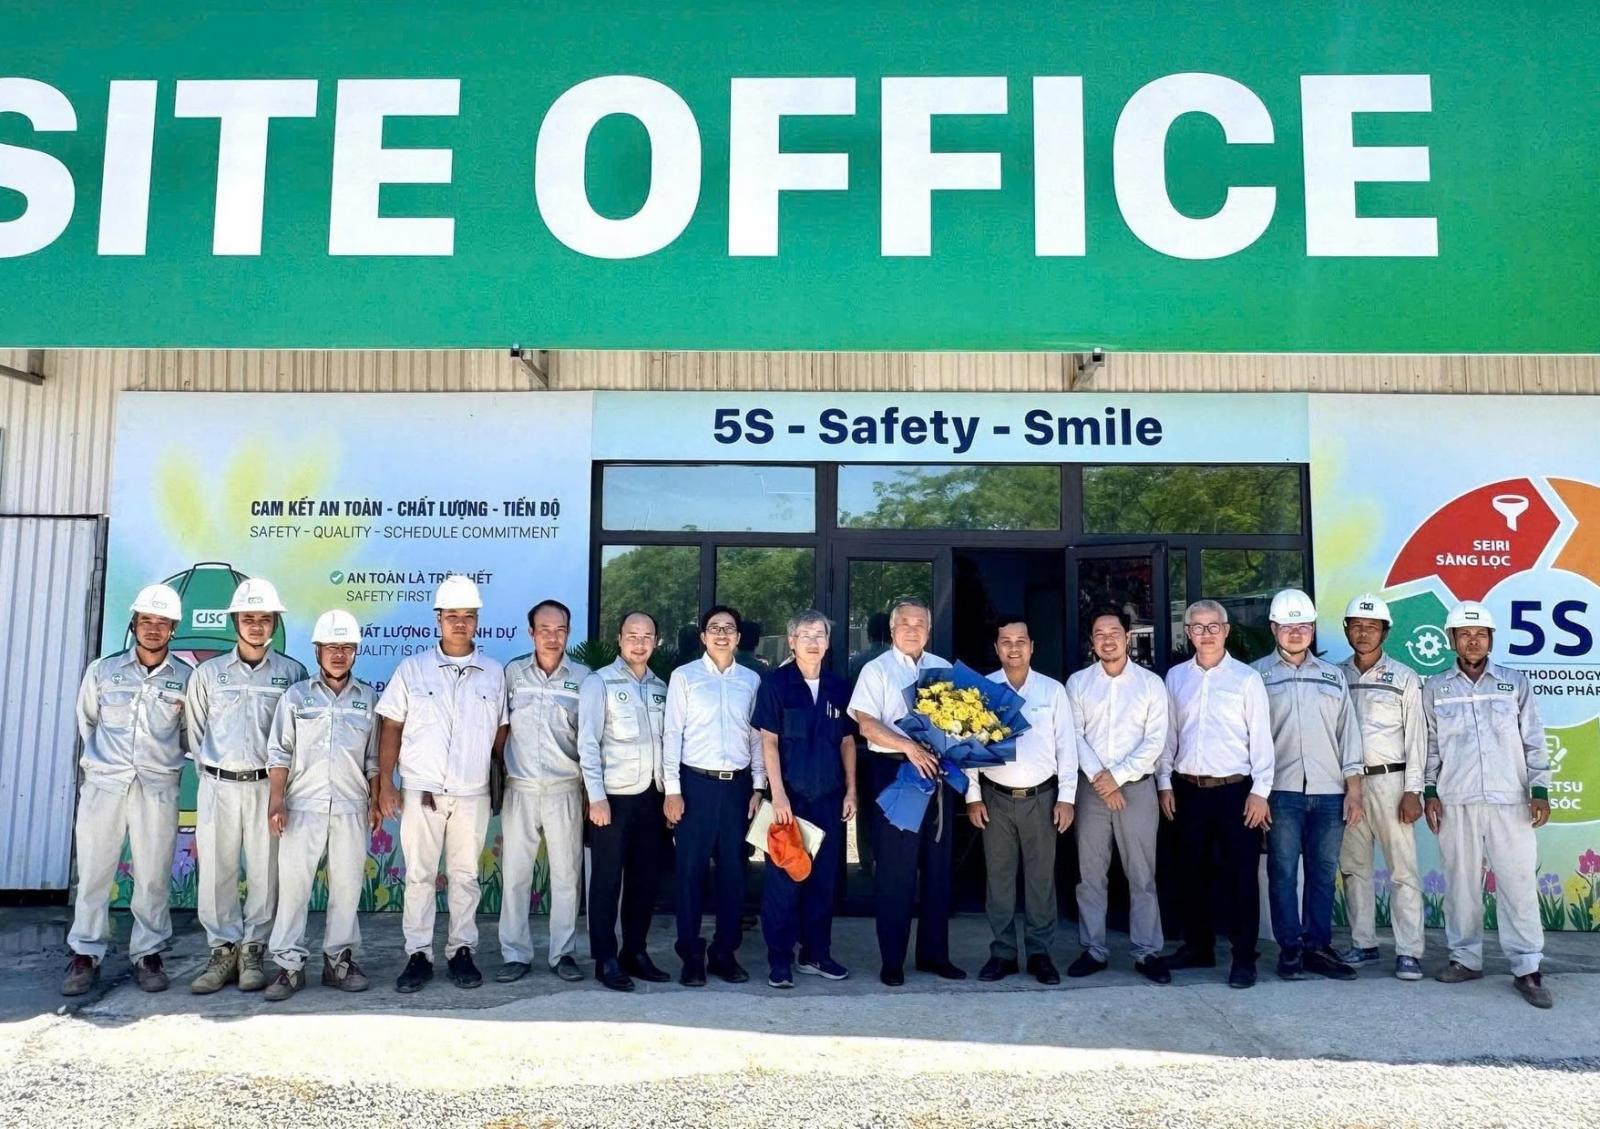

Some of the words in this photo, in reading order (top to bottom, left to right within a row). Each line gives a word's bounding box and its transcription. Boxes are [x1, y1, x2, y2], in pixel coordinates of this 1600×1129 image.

[0, 77, 461, 258] SITE
[534, 72, 1439, 259] OFFICE
[713, 408, 774, 445] 5S
[818, 406, 980, 454] Safety
[1024, 406, 1163, 445] Smile
[251, 500, 284, 517] CAM
[288, 496, 315, 517] KẾT
[319, 500, 340, 517] AN
[344, 498, 383, 517] TOÀN
[397, 496, 435, 517] CHẤT
[439, 499, 488, 520] LƯỢNG
[503, 496, 535, 517] TIẾN
[540, 498, 560, 520] ĐỘ
[250, 525, 300, 538] SAFETY
[313, 525, 372, 539] QUALITY
[383, 526, 458, 539] SCHEDULE
[462, 526, 559, 539] COMMITMENT
[1473, 540, 1510, 551] SEIRI
[1436, 553, 1478, 566] SÀNG
[1481, 555, 1511, 569] LỌC
[347, 572, 366, 584] AN
[369, 570, 405, 584] TOÀN
[408, 570, 425, 584] LÀ
[428, 570, 463, 584] TRÊ
[346, 590, 394, 602] SAFETY
[397, 590, 432, 602] FIRST
[196, 612, 224, 624] CJSC
[384, 625, 431, 641] LƯỢNG
[496, 626, 517, 642] DỰ
[1508, 600, 1593, 657] 5S
[355, 644, 398, 656] UALITY
[400, 645, 412, 656] IS
[1517, 669, 1600, 680] THODOLOGY
